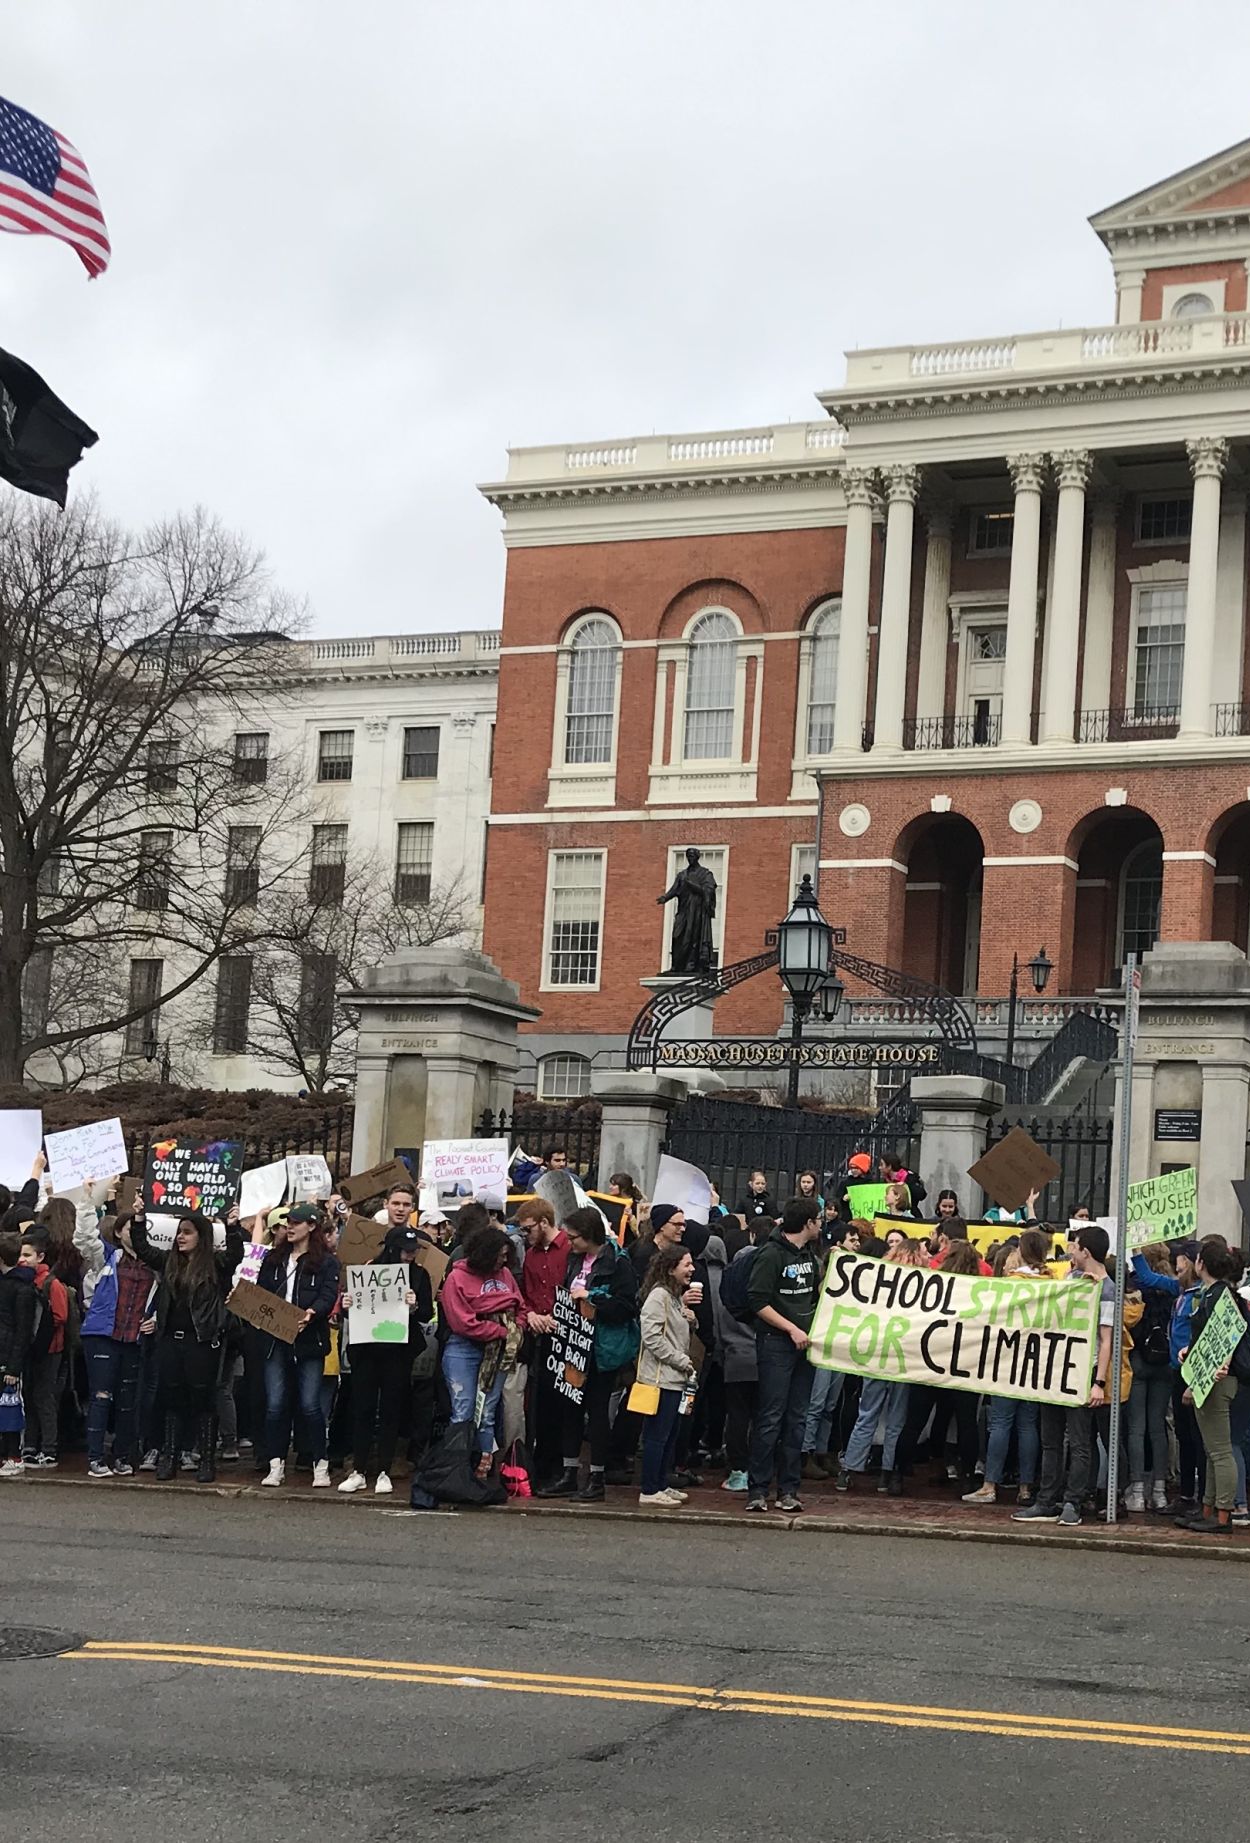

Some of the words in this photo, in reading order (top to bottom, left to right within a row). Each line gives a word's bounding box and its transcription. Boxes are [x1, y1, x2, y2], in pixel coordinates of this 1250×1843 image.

[1148, 1016, 1215, 1026] BULFINCH
[381, 1039, 438, 1048] ENTRANCE
[1144, 1044, 1215, 1055] ENTRANCE
[660, 1048, 809, 1061] MASSACHUSETTS
[815, 1048, 868, 1061] STATE
[874, 1048, 939, 1062] HOUSE
[174, 1149, 192, 1159] WE
[464, 1153, 495, 1164] SMART
[152, 1160, 183, 1171] ONLY
[189, 1161, 219, 1173] HAVE
[434, 1167, 465, 1179] CLIMATE
[470, 1164, 501, 1175] POLICY
[155, 1171, 180, 1181] ONE
[186, 1172, 226, 1184] WORLD
[1159, 1169, 1194, 1194] GREEN
[167, 1182, 182, 1192] SO
[202, 1182, 236, 1197] DON'T
[160, 1195, 192, 1208] FUCK
[204, 1196, 215, 1206] IT
[1144, 1197, 1166, 1216] YOU
[1168, 1188, 1196, 1210] SEE?
[202, 1206, 219, 1216] UP
[351, 1267, 406, 1288] MAGA
[825, 1254, 956, 1316] SCHOOL
[959, 1279, 1095, 1331] STRIKE
[553, 1302, 580, 1327] GIVES
[580, 1315, 595, 1336] YOU
[568, 1329, 593, 1352] RIGHT
[550, 1336, 562, 1353] TO
[564, 1345, 587, 1372] BURN
[822, 1304, 911, 1374] FOR
[920, 1319, 1088, 1395] CLIMATE
[546, 1354, 566, 1378] OUR
[553, 1376, 584, 1405] FUTURE
